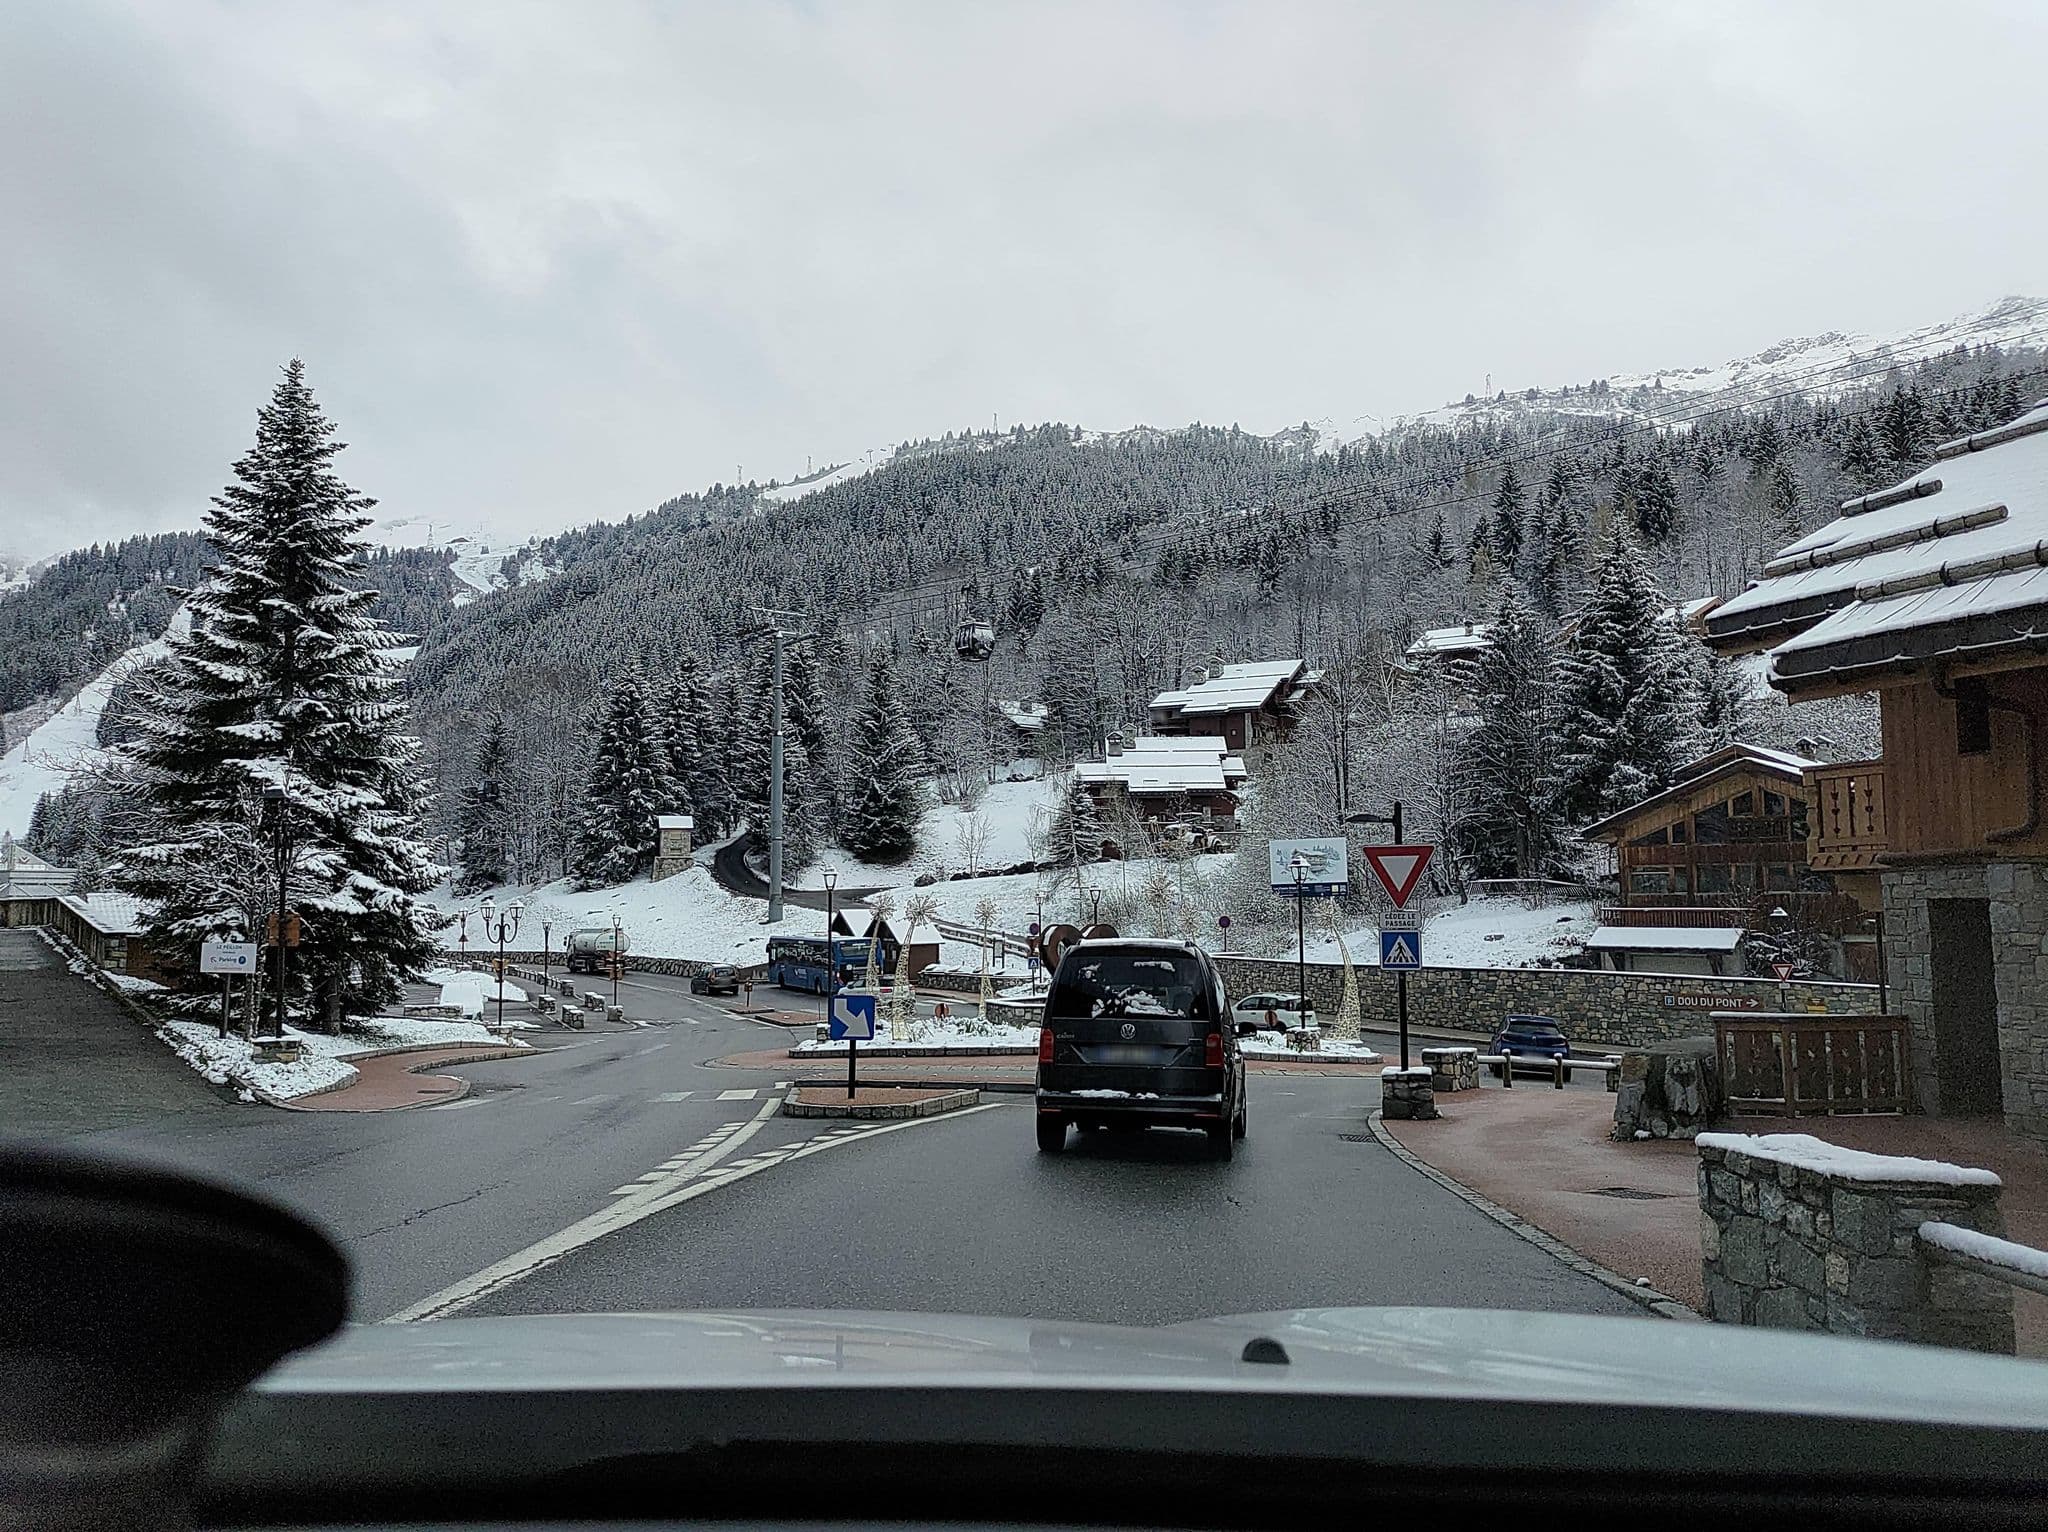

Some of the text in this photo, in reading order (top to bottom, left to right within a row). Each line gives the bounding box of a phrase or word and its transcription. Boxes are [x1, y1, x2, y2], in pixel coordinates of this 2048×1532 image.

[1677, 996, 1698, 1006] DOU
[1700, 997, 1714, 1007] DU
[1715, 998, 1743, 1008] PONT
